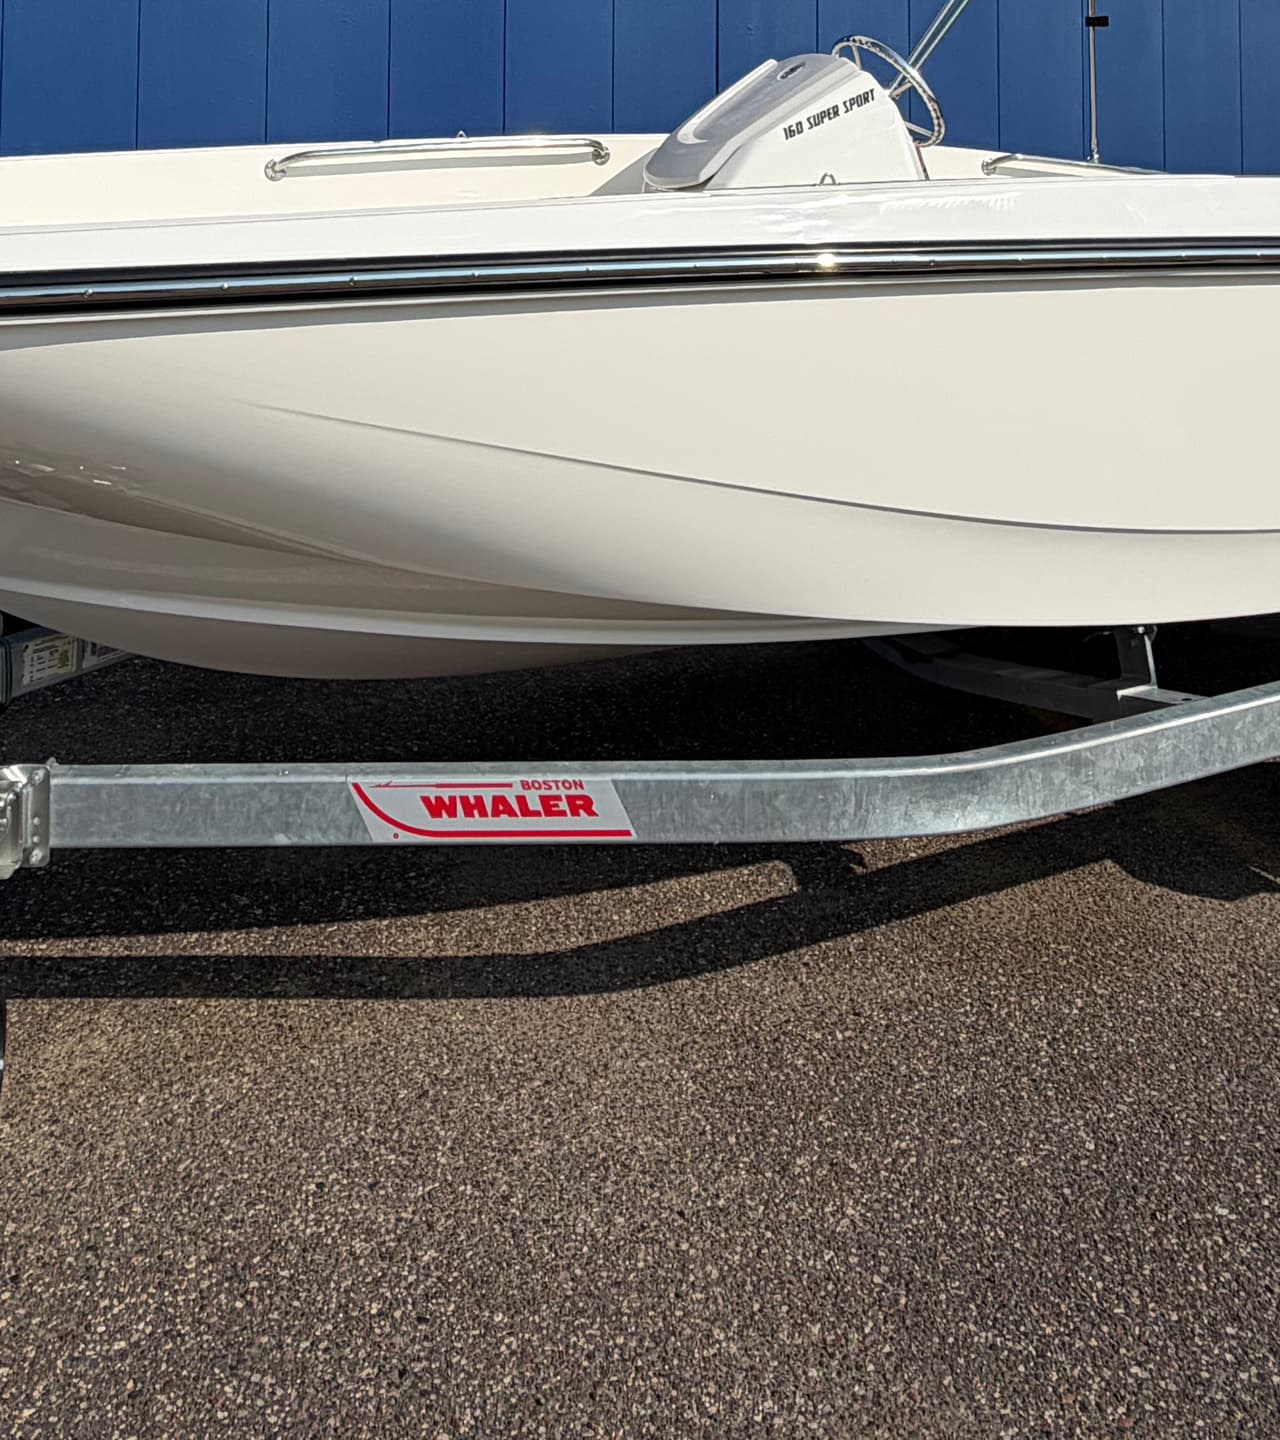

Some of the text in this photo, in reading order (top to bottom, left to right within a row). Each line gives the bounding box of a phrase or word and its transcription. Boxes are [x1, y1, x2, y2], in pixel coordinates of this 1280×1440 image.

[783, 88, 875, 140] 160 SUPER SPORT
[519, 779, 584, 791] BOSTON
[419, 794, 599, 819] WHALER
